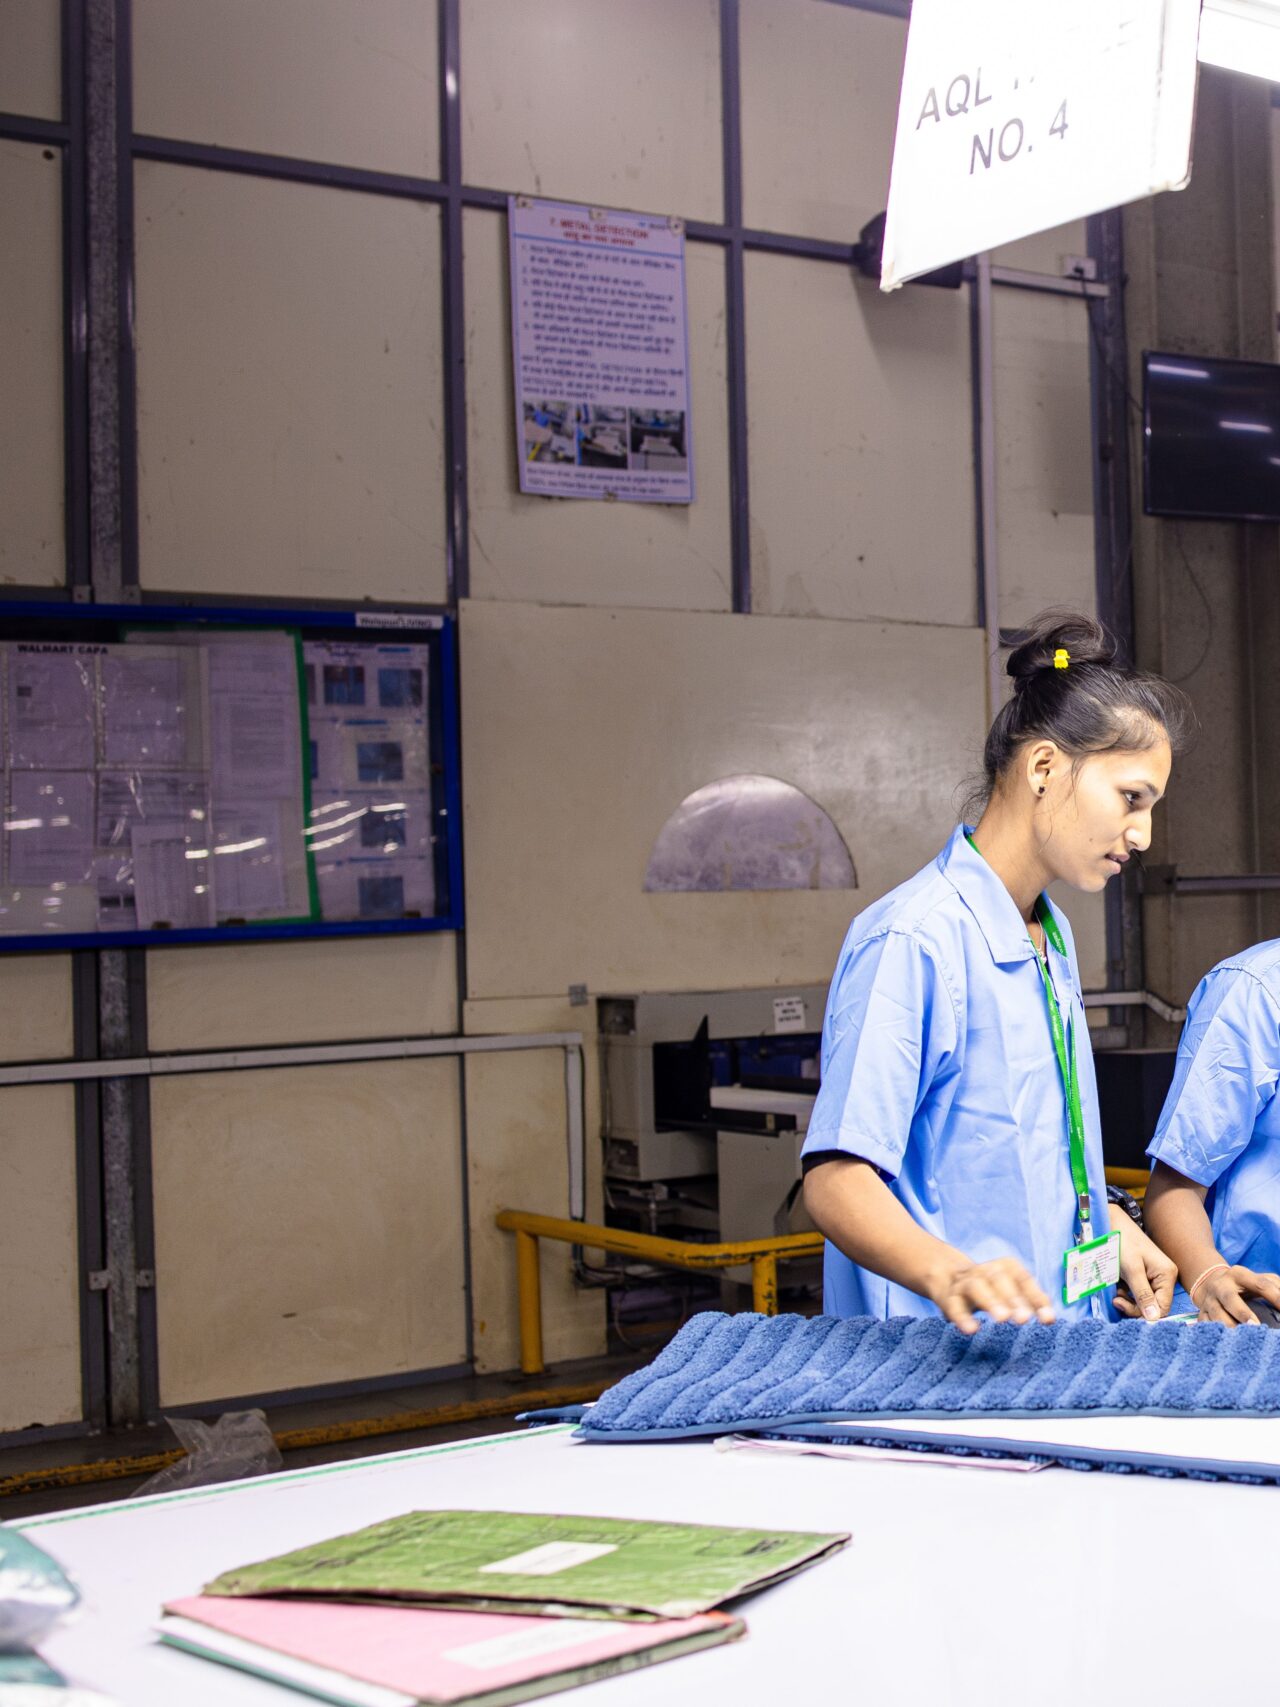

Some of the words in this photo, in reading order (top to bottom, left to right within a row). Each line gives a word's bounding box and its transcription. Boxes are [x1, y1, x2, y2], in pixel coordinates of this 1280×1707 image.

[915, 66, 993, 131] AQL
[969, 117, 1033, 175] NO.
[1048, 98, 1070, 140] 4
[17, 643, 74, 654] WALMART
